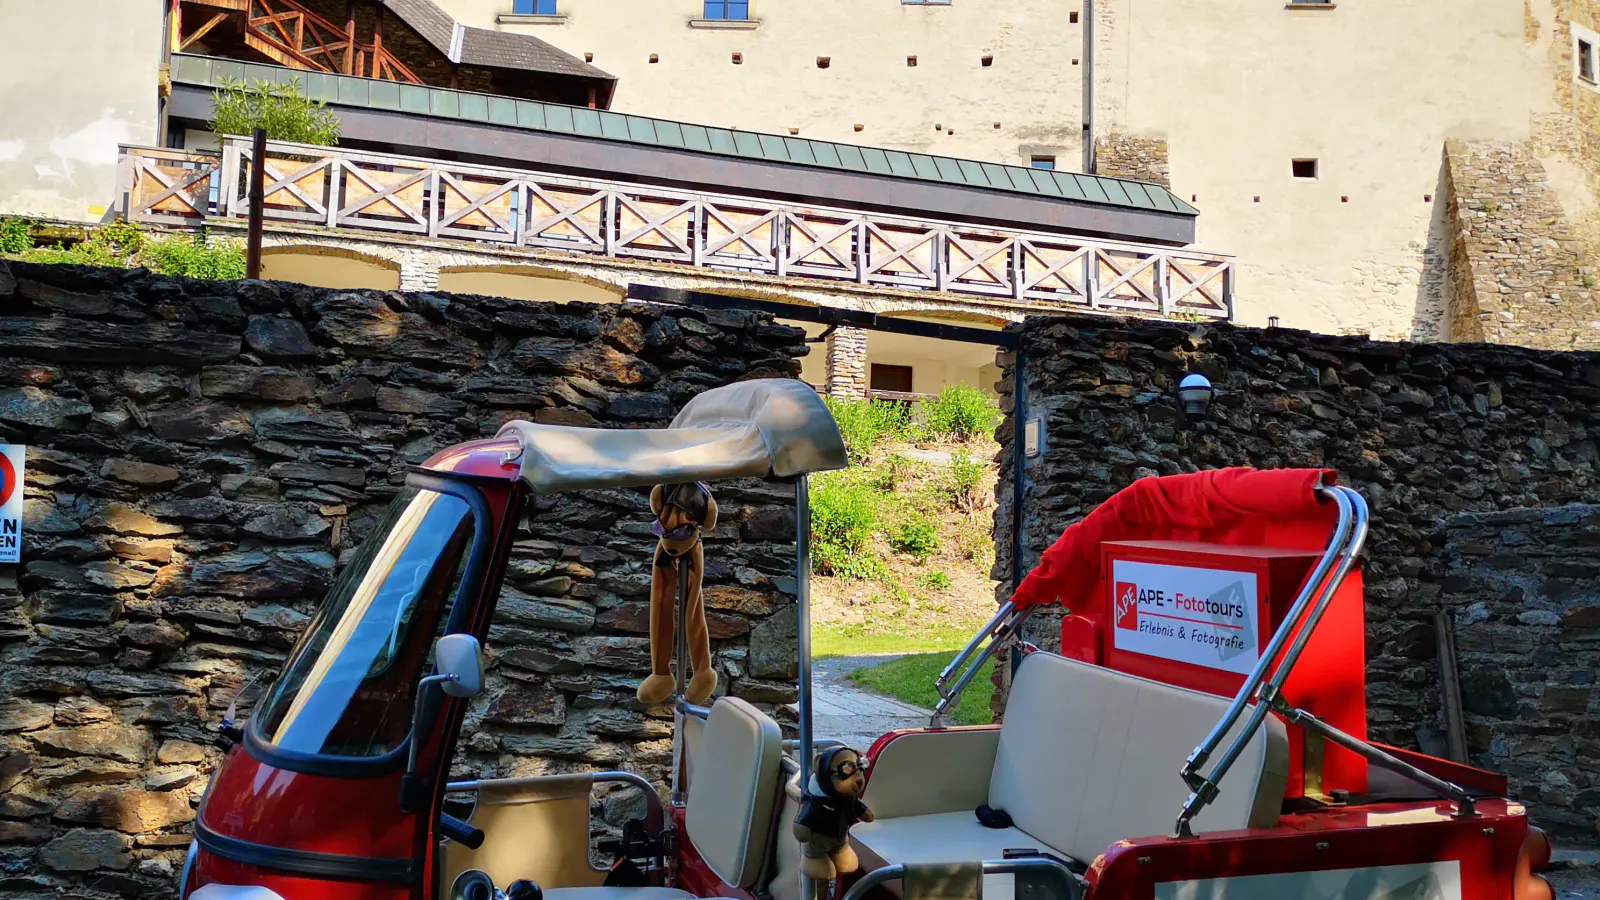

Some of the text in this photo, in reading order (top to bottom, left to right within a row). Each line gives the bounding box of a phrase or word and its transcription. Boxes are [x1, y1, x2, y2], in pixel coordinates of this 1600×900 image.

[1116, 586, 1136, 624] APE
[1138, 589, 1164, 607] APE
[1175, 593, 1243, 618] Fototours
[1139, 620, 1244, 650] Erlebnis & Fotografie
